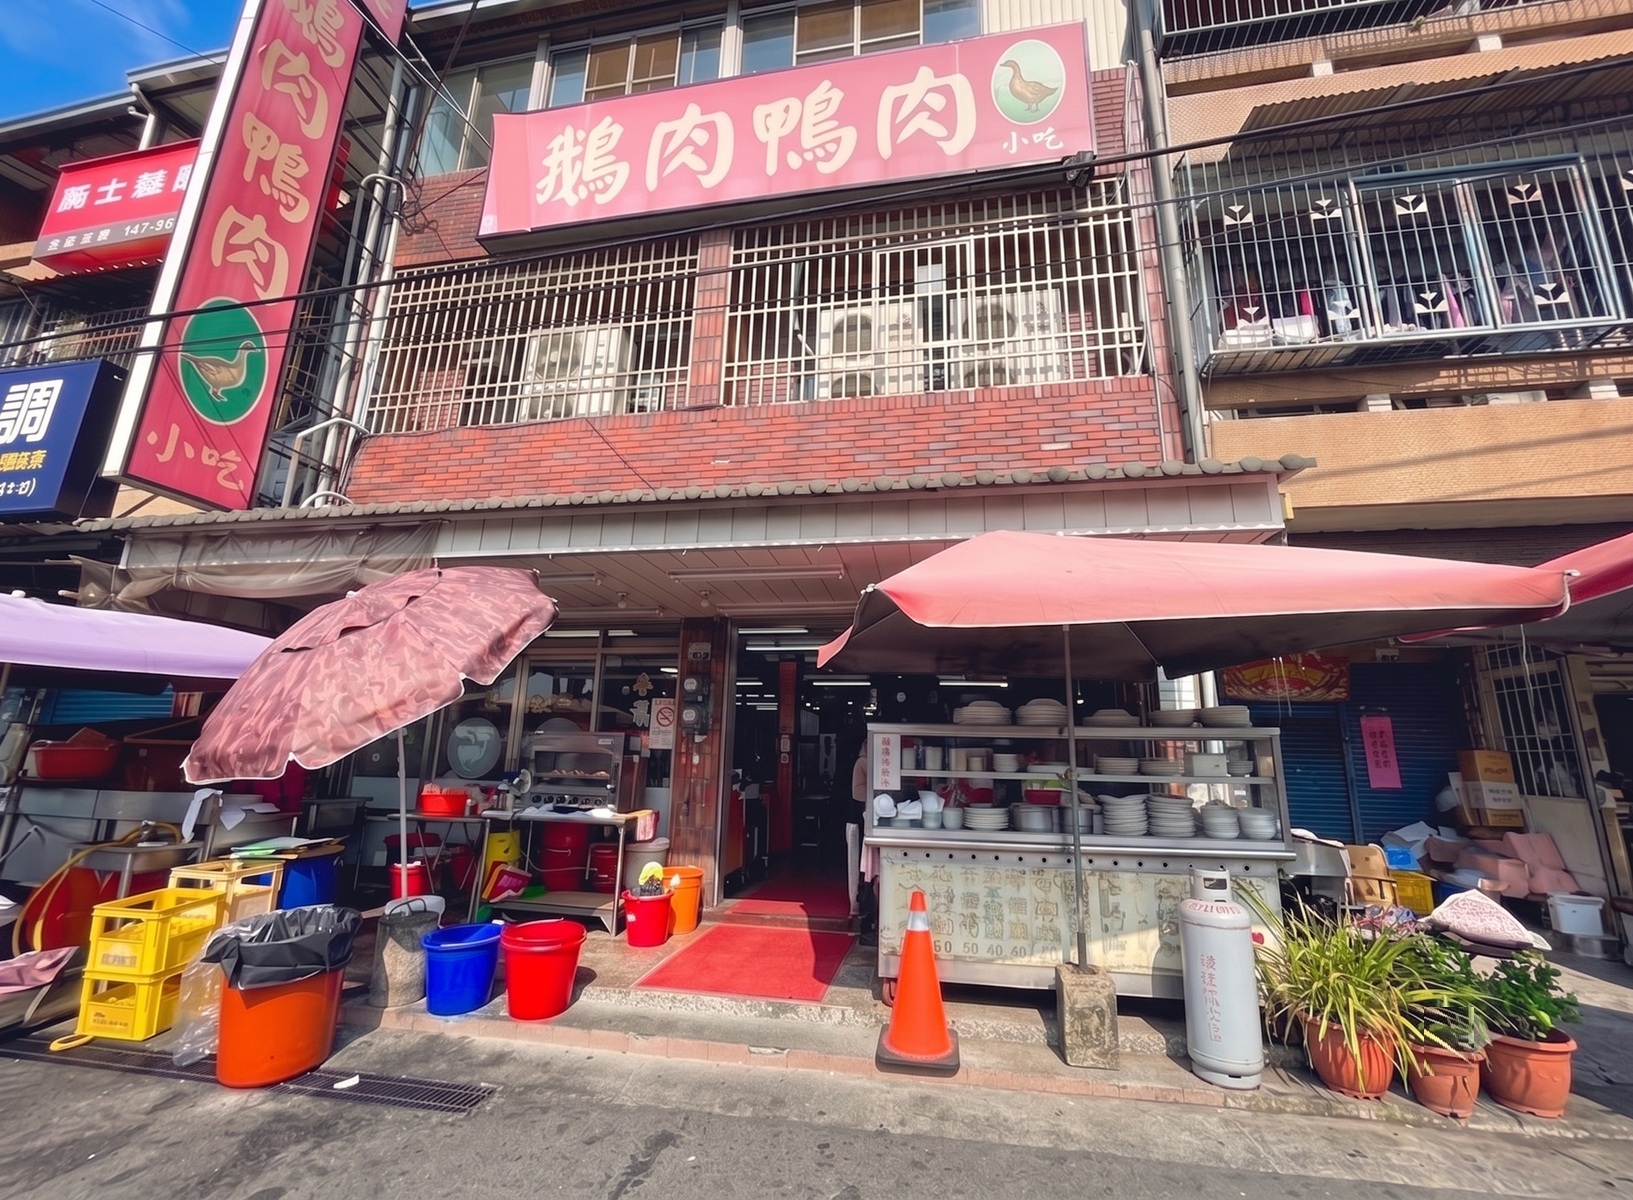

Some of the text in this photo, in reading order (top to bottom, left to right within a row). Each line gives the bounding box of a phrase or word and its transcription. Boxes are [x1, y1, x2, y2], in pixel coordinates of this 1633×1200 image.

[535, 65, 977, 207] 鵝肉鴨肉
[1002, 126, 1065, 155] 小吃
[0, 379, 64, 444] 調
[146, 422, 245, 491] 小吃
